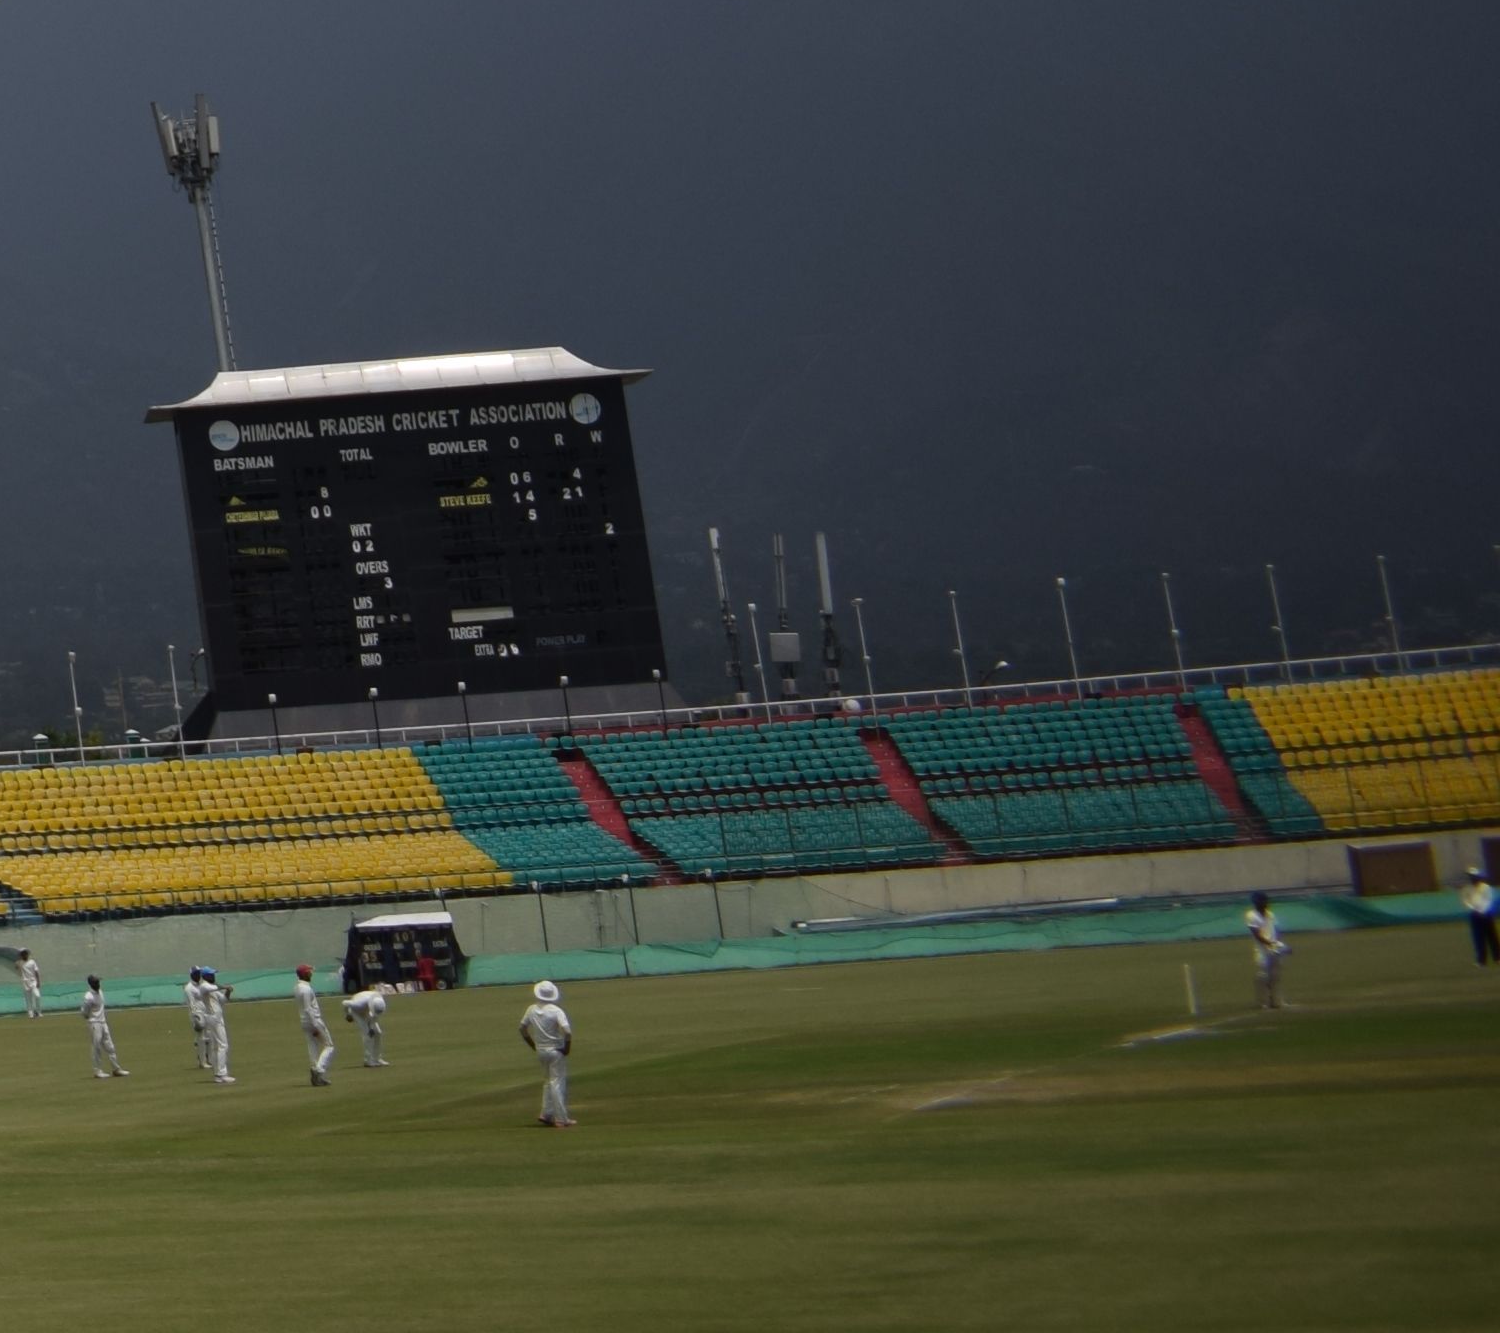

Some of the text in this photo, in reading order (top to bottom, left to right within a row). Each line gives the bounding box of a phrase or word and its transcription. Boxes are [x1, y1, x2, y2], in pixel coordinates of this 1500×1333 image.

[240, 401, 567, 443] HIMACHAL PRADESH CRICKET ASSOCIATION
[554, 432, 565, 446] R
[590, 429, 603, 443] W
[339, 447, 374, 462] TOTAL
[428, 438, 489, 456] BOWLER
[213, 455, 275, 472] BATSMAN
[572, 467, 582, 480] 4
[528, 508, 537, 521] 5
[349, 522, 372, 537] WKT
[605, 522, 614, 534] 2
[355, 560, 389, 575] OVERS
[383, 576, 393, 589] 3
[352, 596, 373, 610] LMS
[356, 614, 376, 629] RRT
[359, 632, 380, 647] LWF
[448, 625, 484, 640] TARGET
[535, 635, 565, 646] POWER
[360, 652, 383, 667] RMO
